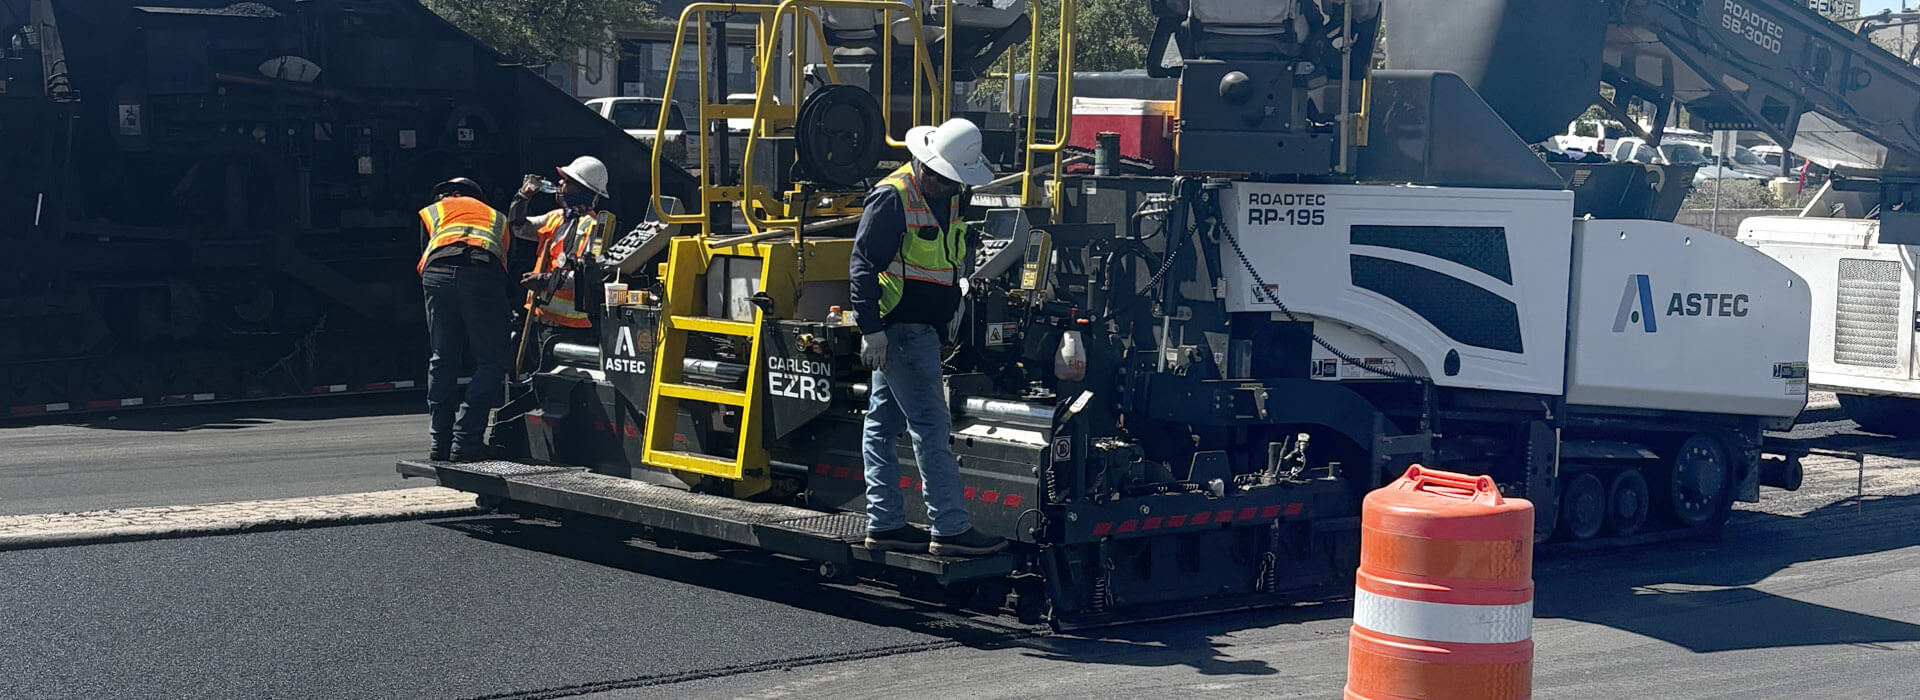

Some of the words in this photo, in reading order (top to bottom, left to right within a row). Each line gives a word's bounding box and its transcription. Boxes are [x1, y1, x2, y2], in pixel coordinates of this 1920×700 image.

[1723, 0, 1784, 39] ROADTEC
[1721, 14, 1782, 55] SB-3000
[1248, 193, 1326, 206] ROADTEC
[1248, 208, 1325, 226] RP-195
[1666, 292, 1749, 317] ASTEC
[605, 357, 646, 374] ASTEC
[768, 356, 831, 376] CARLSON
[768, 371, 831, 403] EZR3
